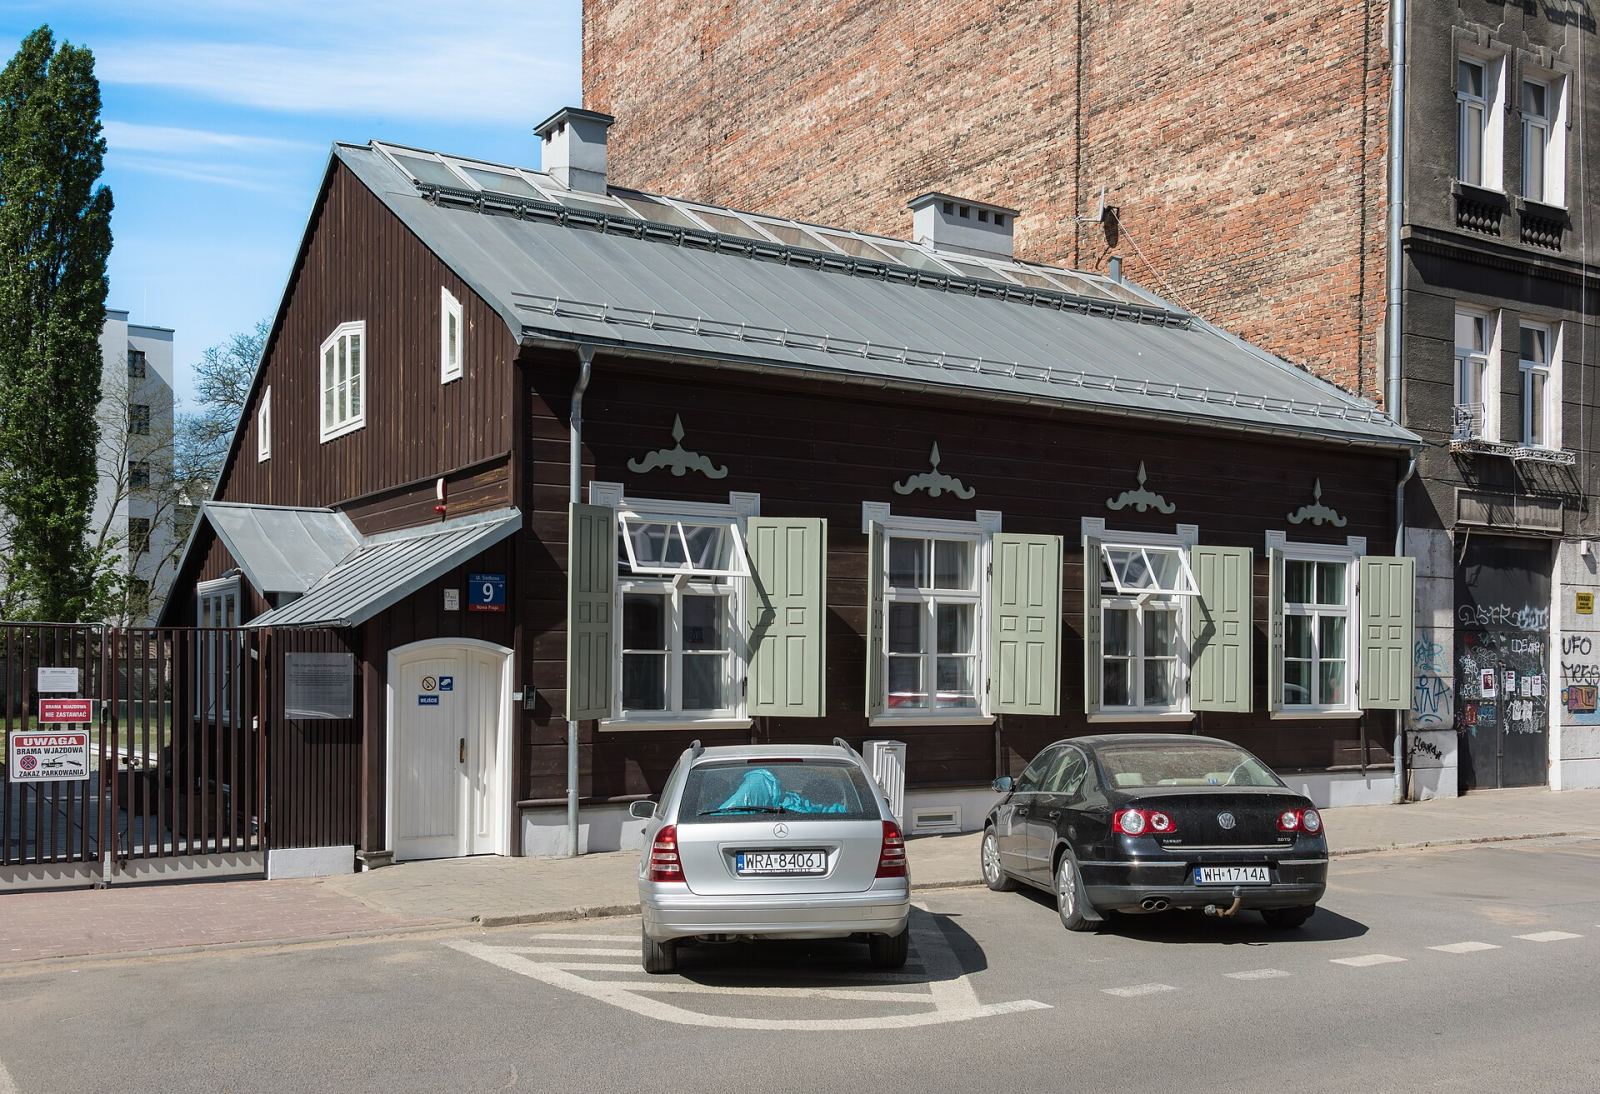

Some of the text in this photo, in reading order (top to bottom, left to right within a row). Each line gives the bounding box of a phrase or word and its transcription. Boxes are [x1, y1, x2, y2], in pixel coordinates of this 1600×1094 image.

[482, 582, 494, 603] 9
[1562, 635, 1592, 656] UFO
[23, 736, 78, 746] UWAGA
[42, 769, 84, 777] PARKOWANIA
[746, 853, 773, 868] WRA
[778, 853, 822, 868] 8406J
[1203, 868, 1221, 881] WH
[1226, 868, 1266, 881] 1714A
